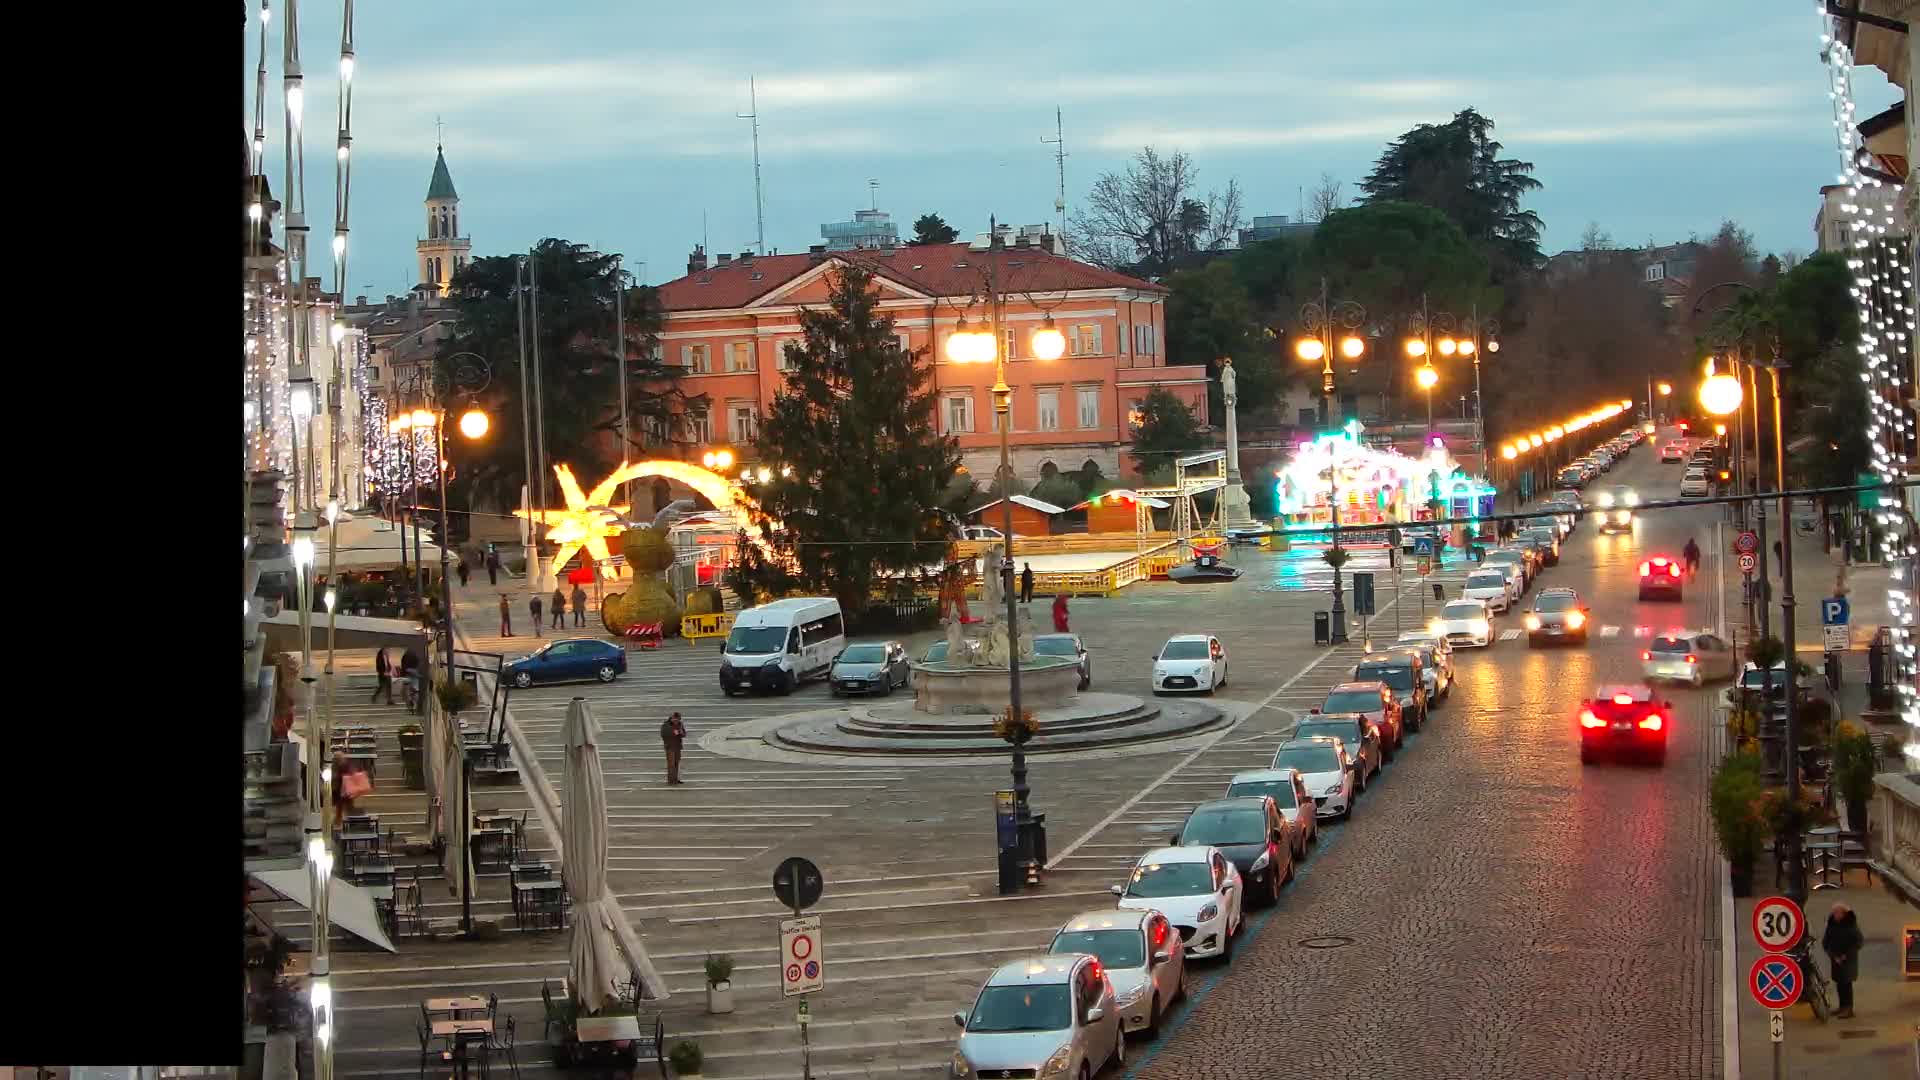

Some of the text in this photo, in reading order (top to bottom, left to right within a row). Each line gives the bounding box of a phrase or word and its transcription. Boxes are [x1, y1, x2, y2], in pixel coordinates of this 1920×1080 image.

[1742, 557, 1753, 567] 20
[1826, 602, 1841, 622] P
[1762, 911, 1791, 938] 30
